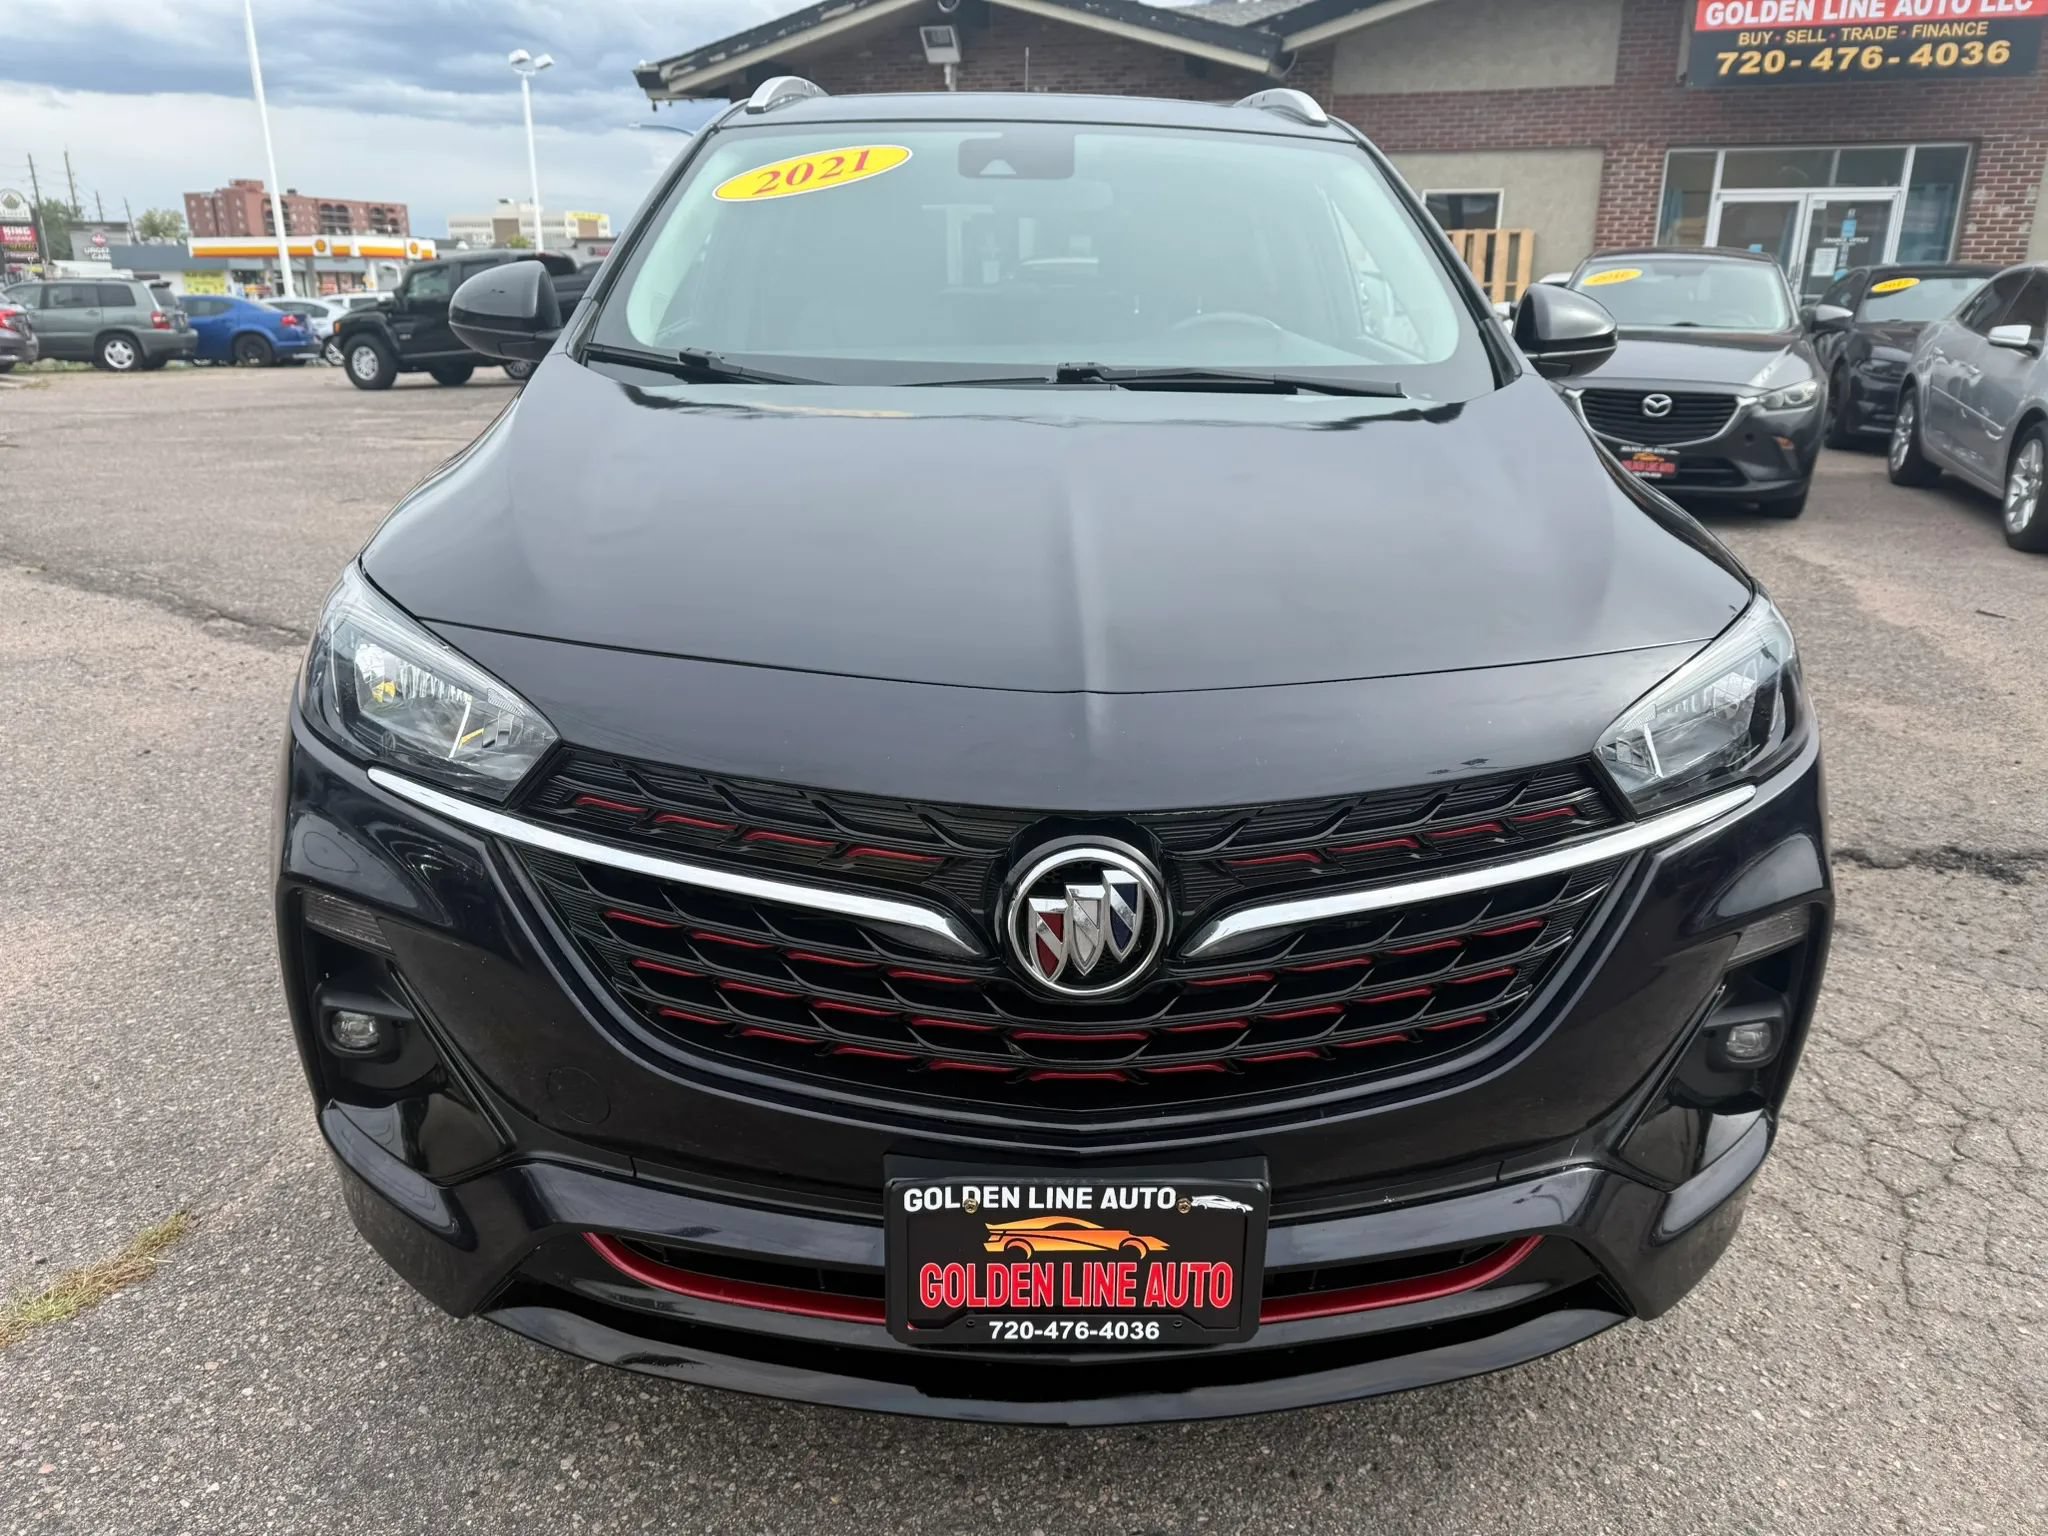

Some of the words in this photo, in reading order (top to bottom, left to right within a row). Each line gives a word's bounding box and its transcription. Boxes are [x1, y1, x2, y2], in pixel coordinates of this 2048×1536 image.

[1705, 0, 1815, 25] GOLDEN
[1822, 0, 1885, 20] LINE
[1892, 0, 1970, 16] AUTO
[1738, 32, 1773, 46] BUY
[1785, 29, 1827, 44] SELL
[1841, 26, 1899, 41] TRADE
[1911, 21, 1989, 38] FINANCE
[751, 149, 871, 196] 2021
[903, 1186, 1020, 1213] GOLDEN
[1028, 1187, 1093, 1210] LINE
[1100, 1186, 1176, 1210] AUTO
[919, 1262, 1054, 1309] GOLDEN
[1062, 1261, 1137, 1308] LINE
[1143, 1261, 1234, 1309] AUTO
[989, 1320, 1160, 1341] 720-476-4036
